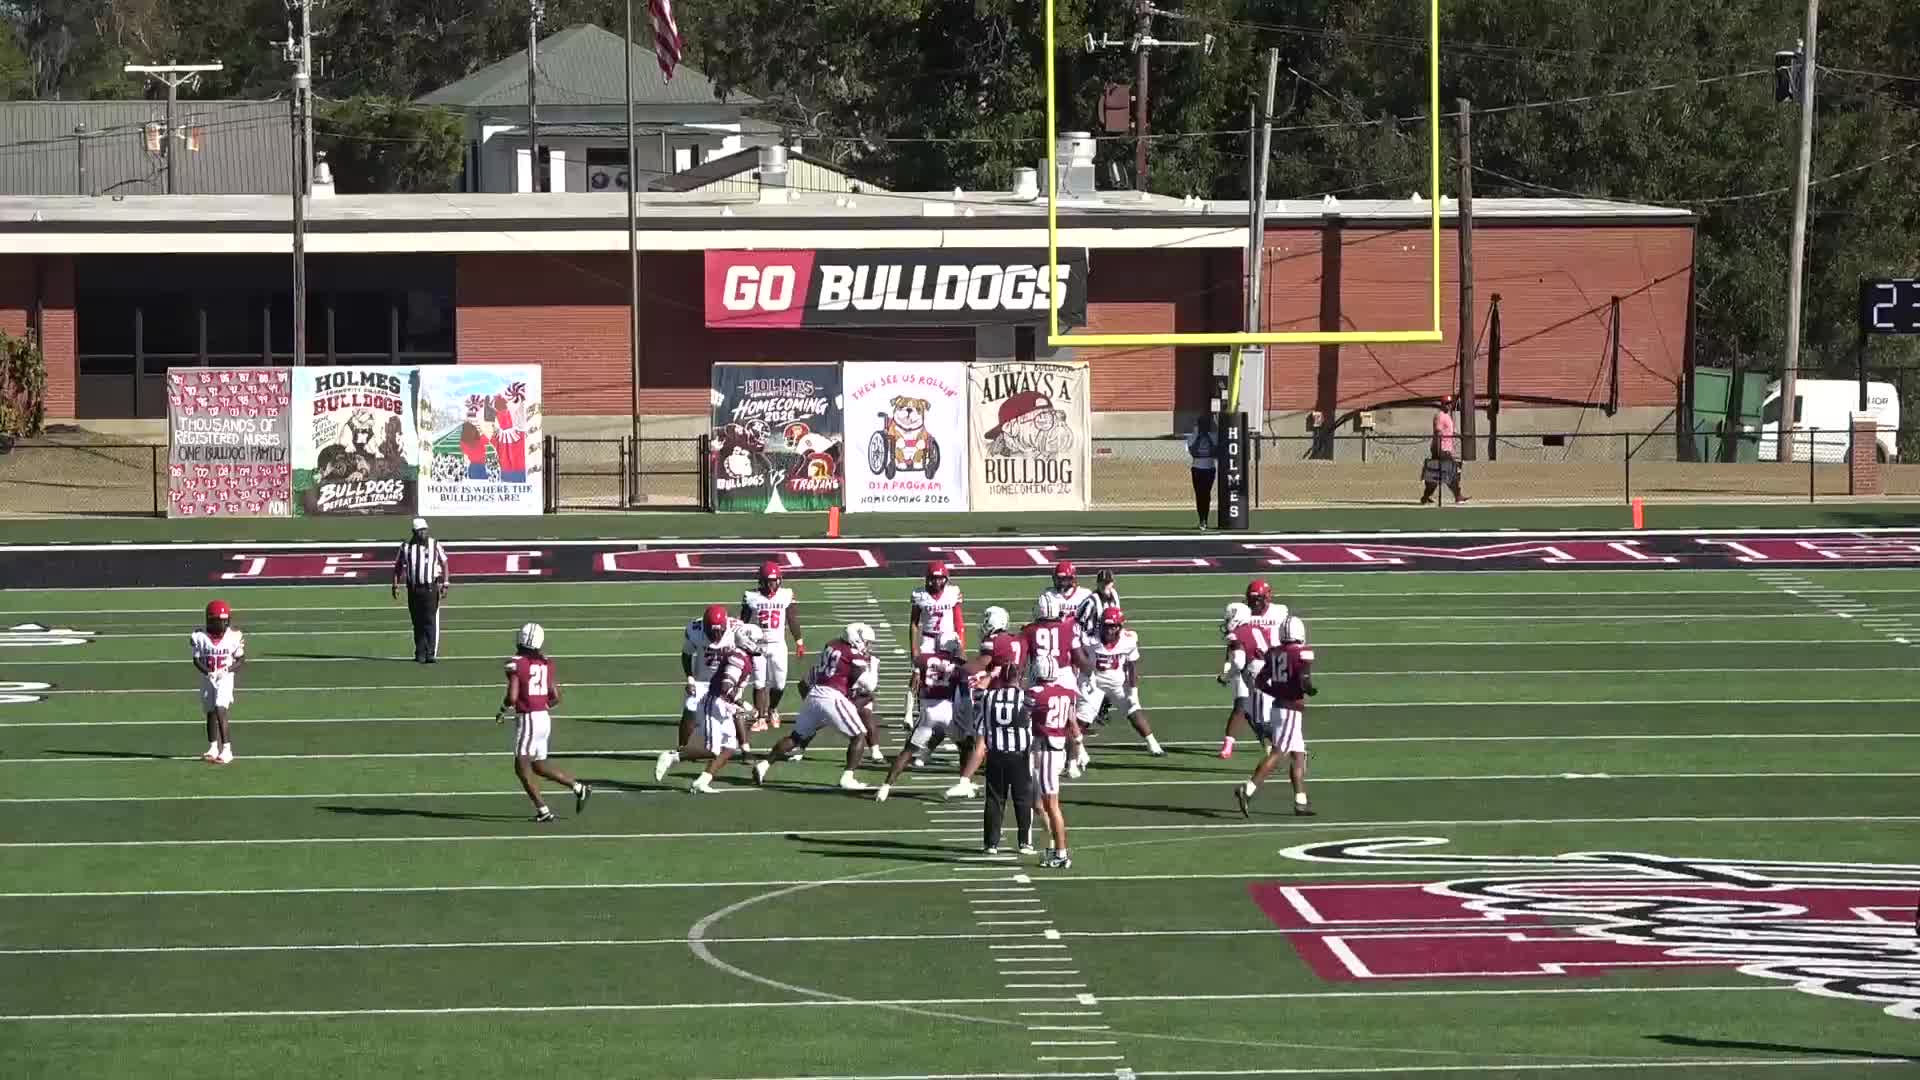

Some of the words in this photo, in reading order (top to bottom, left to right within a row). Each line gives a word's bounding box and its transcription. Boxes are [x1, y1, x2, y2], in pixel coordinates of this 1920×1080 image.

[723, 265, 796, 310] GO
[818, 264, 1071, 310] BULLDOGS
[315, 371, 400, 394] HOLMES
[745, 378, 816, 395] HOLMES
[902, 374, 915, 383] US
[981, 371, 1054, 404] ALWAYS
[1059, 380, 1071, 400] A
[313, 394, 403, 416] BULLDOGS
[731, 398, 829, 420] HOMECOMING
[179, 417, 255, 432] THOUSANDS
[260, 418, 276, 432] OF
[765, 411, 795, 421] 2026
[175, 430, 239, 444] REGISTERED
[244, 433, 280, 445] NURSES
[179, 446, 200, 460] ONE
[205, 446, 245, 460] BULLDOG
[251, 447, 287, 461] FAMILY
[717, 474, 764, 490] BULLDOGS
[769, 469, 785, 486] VS
[791, 478, 838, 490] TROJANS
[985, 459, 1072, 483] BULLDOG
[1227, 426, 1240, 518] HOLMES
[317, 479, 404, 505] BULLDOGS
[427, 485, 459, 493] HOME
[462, 485, 471, 493] IS
[474, 485, 509, 493] WHERE
[513, 485, 533, 493] THE
[440, 494, 494, 502] BULLDOGS
[990, 485, 1053, 495] HOMECOMING
[269, 501, 288, 515] ADN
[323, 497, 353, 511] DEFEAT
[861, 495, 921, 504] HOMECOMING
[925, 495, 950, 503] 2026
[758, 610, 780, 629] 26
[928, 611, 944, 631] 7
[1036, 627, 1060, 657] 91
[1272, 651, 1288, 682] 12
[528, 664, 548, 696] 21
[994, 702, 1014, 725] U
[1046, 695, 1071, 729] 20
